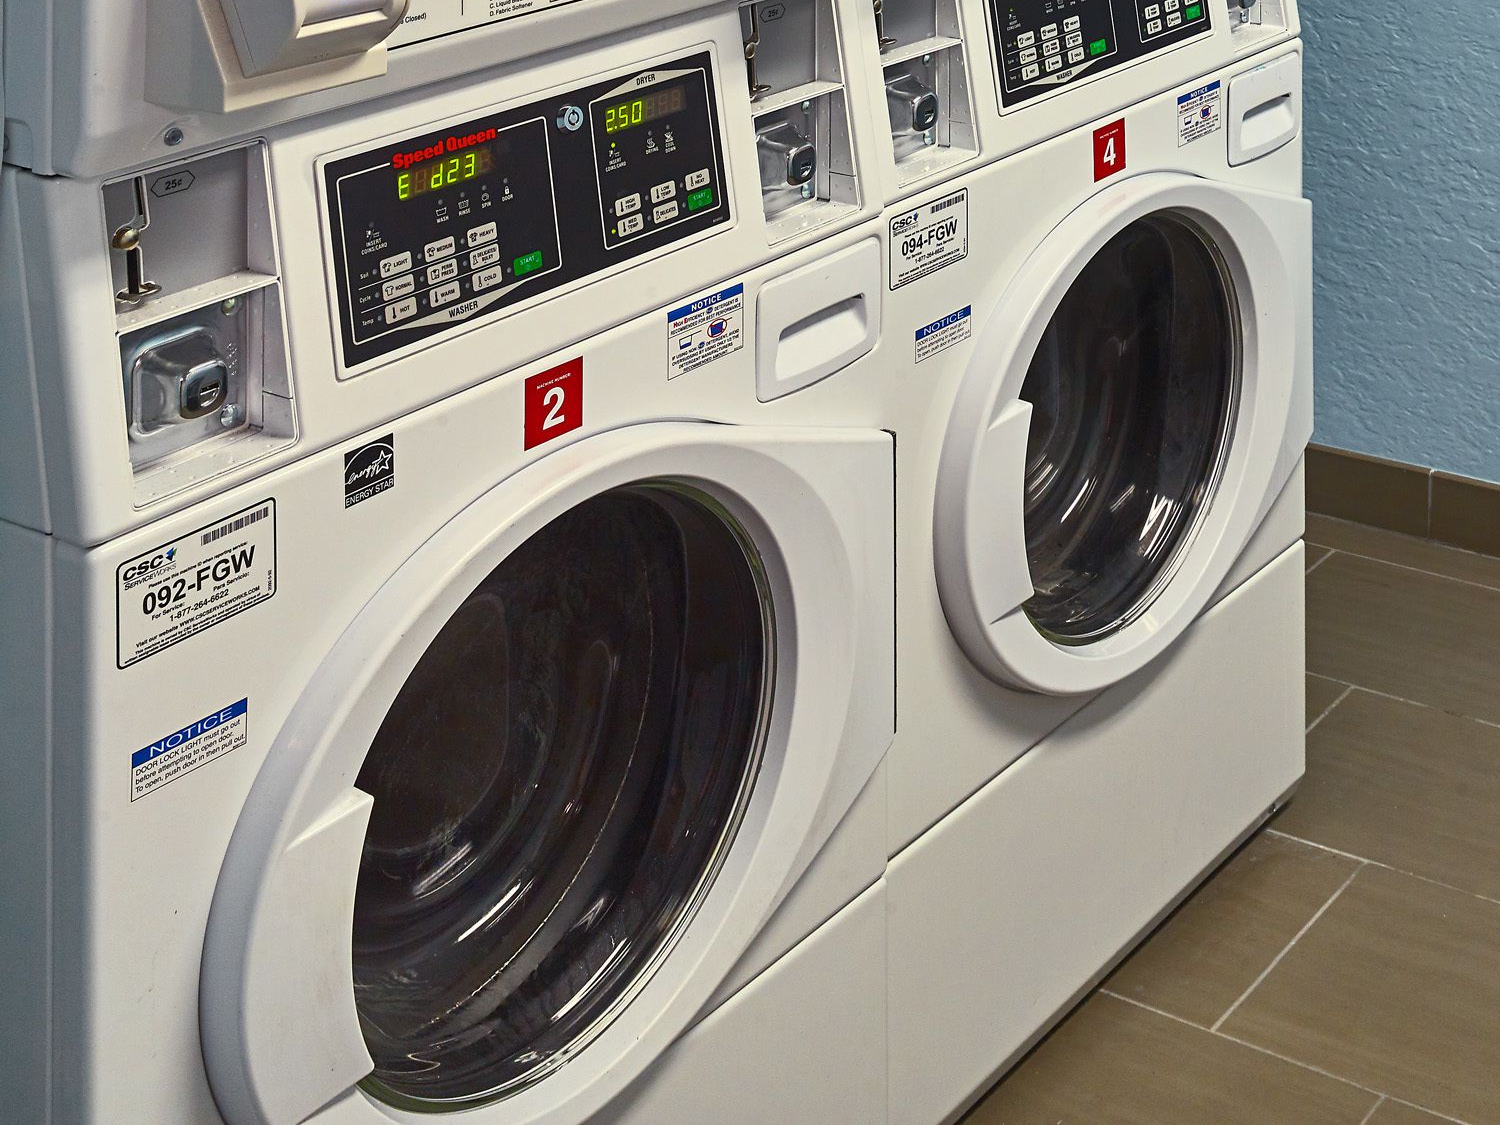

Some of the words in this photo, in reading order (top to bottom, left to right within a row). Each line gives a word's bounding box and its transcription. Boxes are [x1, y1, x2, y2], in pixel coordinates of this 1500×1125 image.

[636, 73, 655, 85] DRYER
[1190, 86, 1207, 98] NOTICE
[604, 100, 643, 131] 2.50
[393, 139, 443, 169] Speed
[446, 130, 496, 151] Queen
[1103, 138, 1116, 166] 4
[396, 174, 410, 199] E
[478, 227, 494, 238] HEAVY
[892, 215, 911, 230] CSC
[436, 241, 452, 253] MEDIUM
[901, 218, 956, 257] 094-FGW
[392, 257, 408, 268] LIGHT
[519, 254, 535, 265] START
[483, 272, 497, 282] COLD
[440, 287, 455, 298] WARM
[691, 293, 721, 311] NOTICE
[399, 304, 410, 314] HOT
[448, 300, 478, 318] WASHER
[923, 309, 963, 336] NOTICE
[543, 386, 565, 430] 2
[346, 486, 373, 506] ENERGY
[375, 477, 393, 493] STAR
[122, 553, 163, 582] CSC
[142, 544, 255, 617] 092-FGW
[152, 611, 161, 620] For
[162, 600, 184, 615] Service:
[169, 588, 228, 622] 1-877-264-6622
[150, 706, 232, 757] NOTICE
[135, 759, 157, 776] DOOR
[159, 748, 179, 764] LOCK
[181, 737, 201, 753] LIGHT
[204, 729, 219, 742] must
[221, 725, 228, 734] go
[230, 719, 240, 729] out
[135, 769, 155, 785] before
[158, 751, 191, 774] attempting
[193, 747, 199, 755] to
[201, 739, 216, 753] open
[136, 783, 143, 793] To
[164, 764, 181, 779] push
[182, 757, 196, 769] door
[206, 745, 219, 757] then
[221, 738, 232, 750] pull
